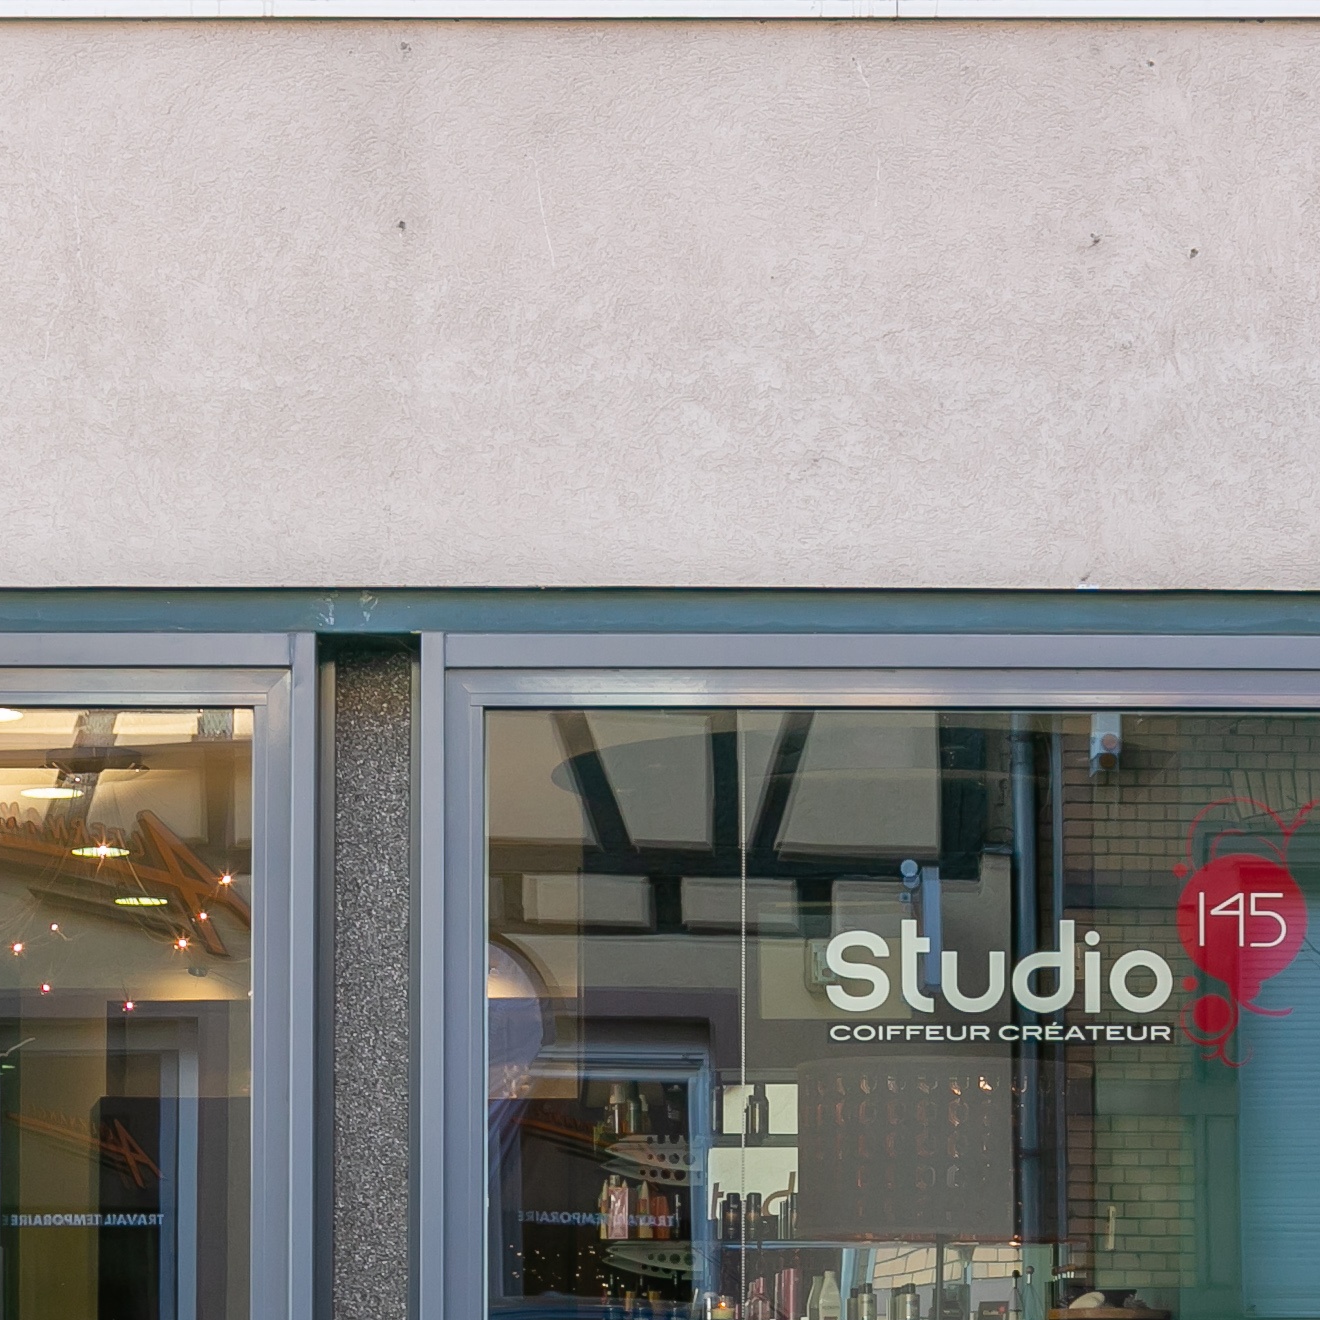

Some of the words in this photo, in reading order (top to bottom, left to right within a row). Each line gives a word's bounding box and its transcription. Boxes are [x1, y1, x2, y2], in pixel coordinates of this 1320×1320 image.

[1198, 891, 1288, 948] 145
[825, 919, 1174, 1014] Studio
[829, 1024, 991, 1042] COIFFEUR
[998, 1021, 1171, 1041] CRÉATEUR
